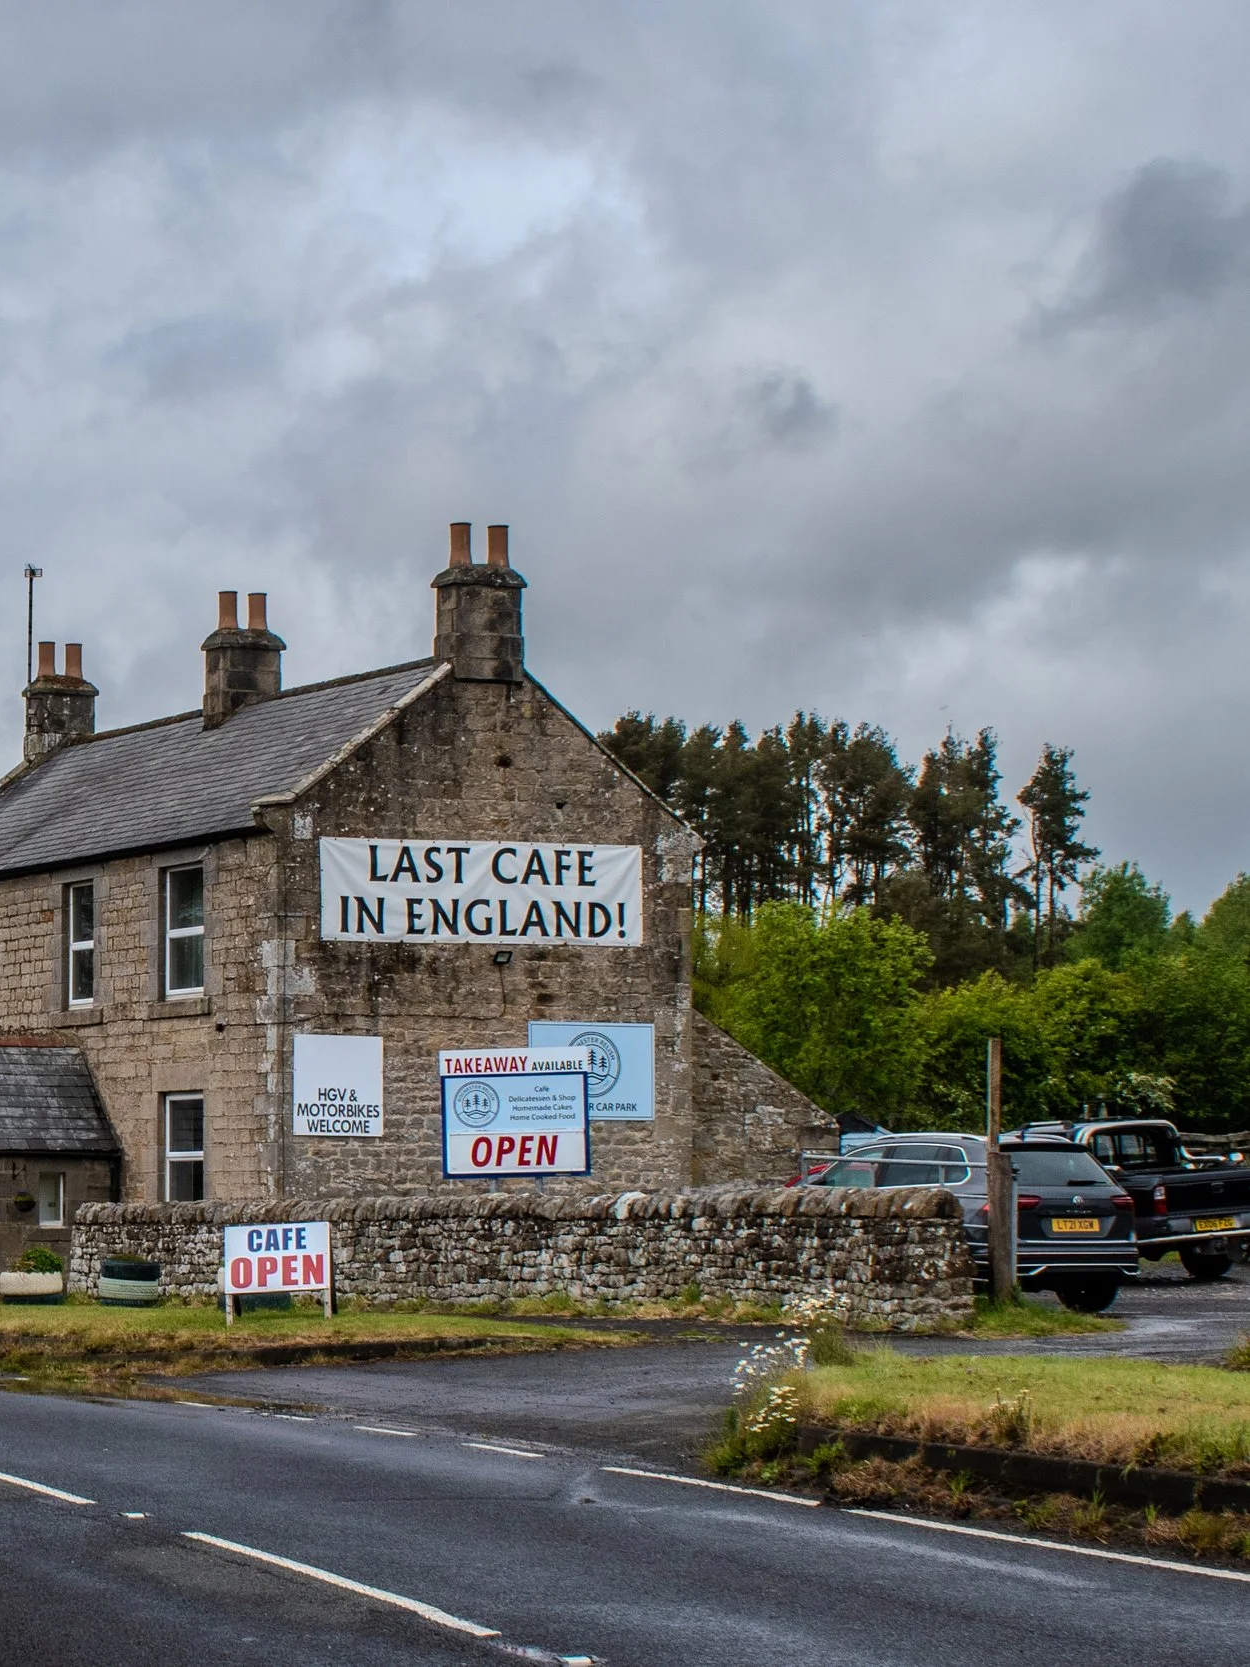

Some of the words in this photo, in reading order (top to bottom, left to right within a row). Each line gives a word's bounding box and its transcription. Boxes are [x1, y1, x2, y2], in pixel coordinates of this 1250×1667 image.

[367, 844, 472, 885] LAST
[491, 846, 598, 888] CAFE
[339, 895, 386, 935] IN
[405, 897, 628, 940] ENGLAND!
[444, 1055, 529, 1074] TAKEAWAY
[531, 1059, 583, 1072] AVAILABLE
[317, 1087, 347, 1102] HGV
[348, 1088, 358, 1102] &
[508, 1095, 551, 1103] Delicatessen
[558, 1094, 576, 1102] Shop
[296, 1102, 380, 1119] MOTORBIKES
[512, 1104, 552, 1112] Homemade
[552, 1103, 573, 1111] Cakes
[595, 1102, 614, 1112] CAR
[615, 1102, 638, 1112] PARK
[531, 1113, 557, 1121] Cooked
[306, 1119, 371, 1134] WELCOME
[470, 1134, 559, 1168] OPEN
[246, 1227, 307, 1253] CAFE
[230, 1253, 325, 1290] OPEN
